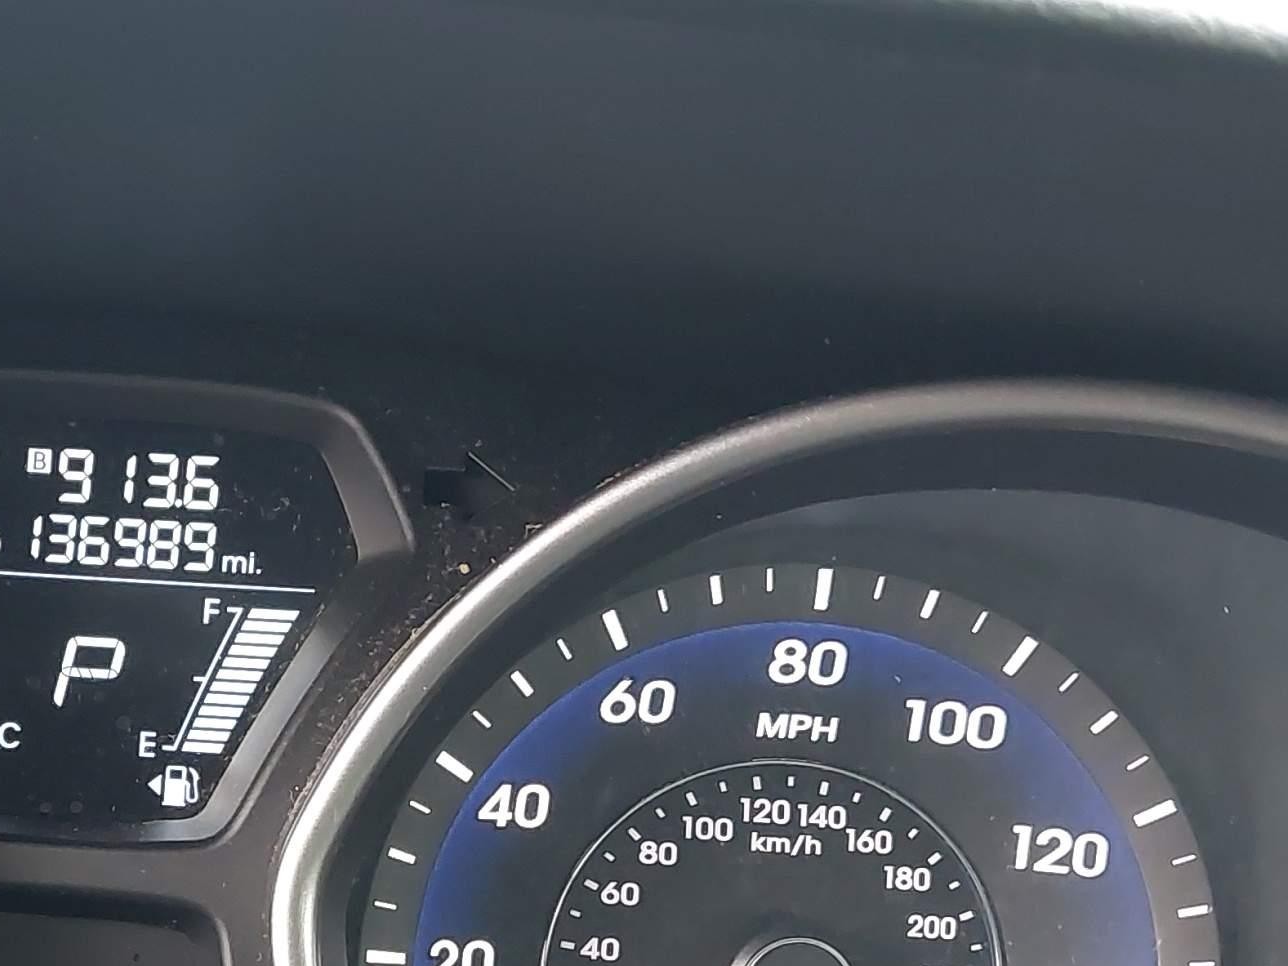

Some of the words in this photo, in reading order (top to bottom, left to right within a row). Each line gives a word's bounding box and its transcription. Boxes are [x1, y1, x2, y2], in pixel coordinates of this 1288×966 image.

[58, 448, 220, 511] 913.6
[30, 513, 217, 572] 136989
[221, 551, 262, 575] mi.
[202, 597, 221, 625] F
[53, 635, 126, 707] P
[768, 638, 848, 686] 80
[599, 679, 676, 724] 60
[755, 712, 839, 742] MPH
[905, 699, 1007, 749] 100
[138, 730, 157, 758] E
[477, 783, 550, 829] 40
[740, 797, 791, 825] 120
[797, 803, 847, 830] 140
[682, 815, 734, 842] 100
[845, 828, 893, 855] 160
[638, 840, 678, 866] 80
[750, 831, 822, 856] km/h
[1012, 824, 1109, 878] 120
[883, 865, 931, 892] 180
[600, 881, 640, 906] 60
[906, 914, 957, 940] 200
[580, 937, 620, 961] 40
